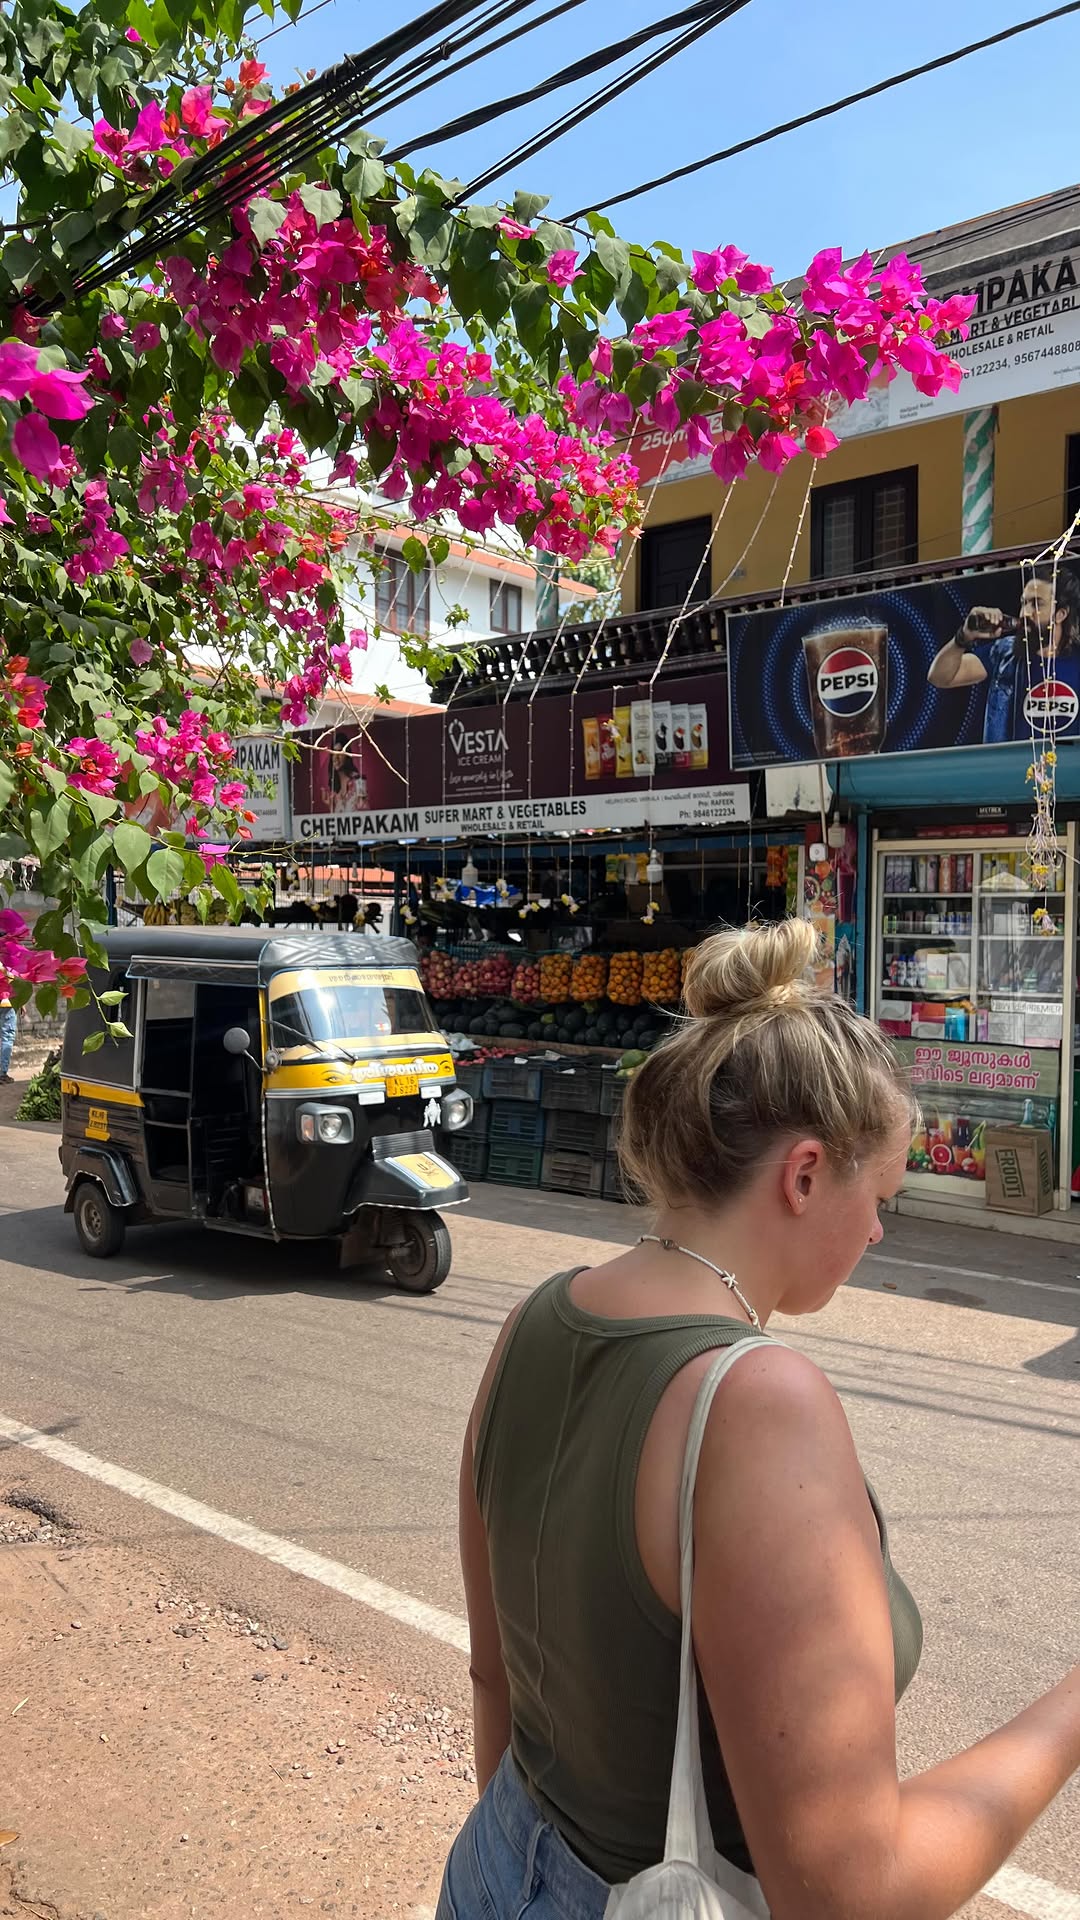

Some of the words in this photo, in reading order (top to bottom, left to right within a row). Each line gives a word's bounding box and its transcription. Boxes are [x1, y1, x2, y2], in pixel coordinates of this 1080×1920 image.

[950, 320, 988, 342] MRT
[991, 316, 1000, 331] &
[1007, 333, 1013, 345] &
[1016, 323, 1054, 341] RETAIL
[820, 672, 875, 691] PEPSI
[1026, 700, 1076, 713] PEPSI
[448, 719, 509, 755] VESTA
[457, 756, 471, 766] ICE
[472, 754, 502, 765] CREAM
[300, 812, 419, 837] CHEMPAKAM
[424, 808, 459, 824] SUPER
[462, 806, 493, 821] MART
[496, 805, 504, 819] &
[508, 800, 587, 819] VEGETABLES
[461, 821, 507, 833] WHOLESALE
[509, 821, 514, 830] &
[517, 820, 544, 830] RETAIL
[915, 1047, 942, 1065] ഈ
[999, 1148, 1022, 1198] FROOTI
